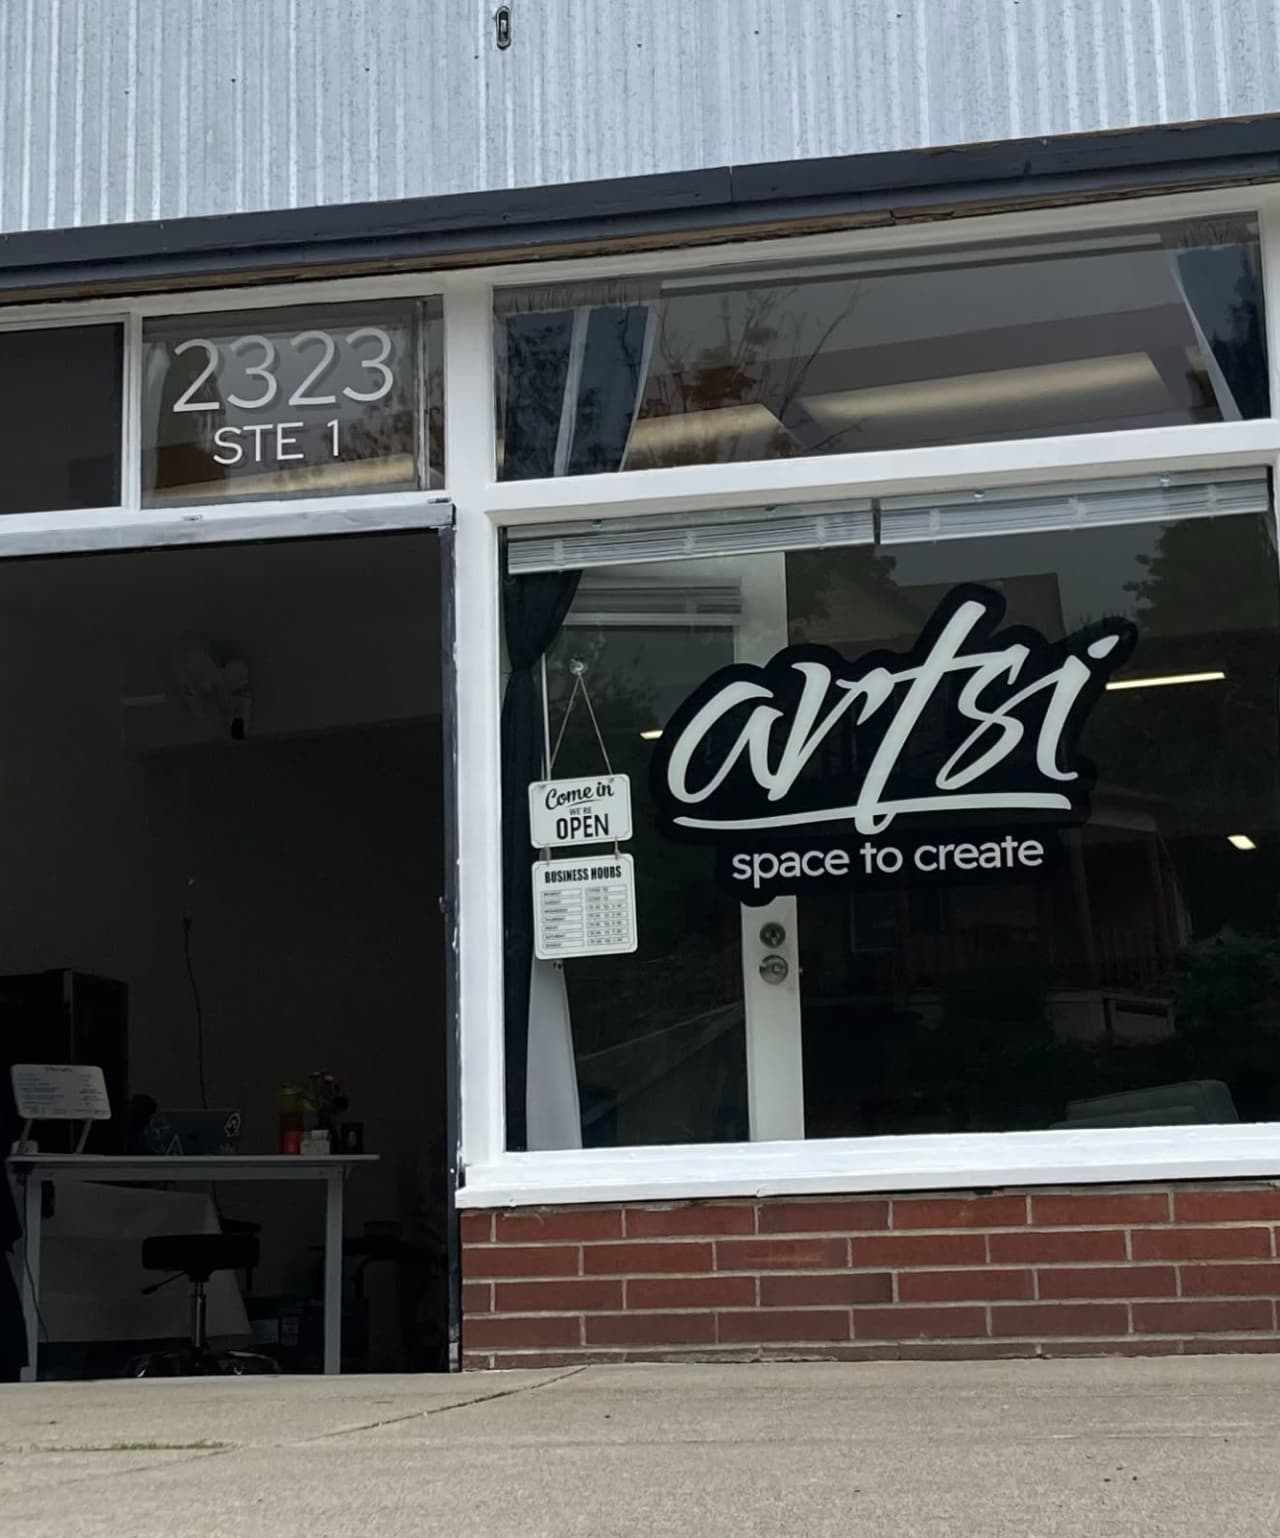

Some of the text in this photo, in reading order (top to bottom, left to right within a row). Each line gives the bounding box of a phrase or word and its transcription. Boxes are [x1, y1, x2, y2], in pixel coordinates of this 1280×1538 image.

[173, 327, 395, 413] 2323
[213, 420, 340, 466] STE 1
[667, 600, 1120, 836] artsi
[545, 781, 615, 810] Come in
[569, 807, 592, 816] WE'RE
[556, 813, 609, 840] OPEN
[544, 865, 622, 884] BUSINESS HOURS
[731, 834, 1045, 889] space to create
